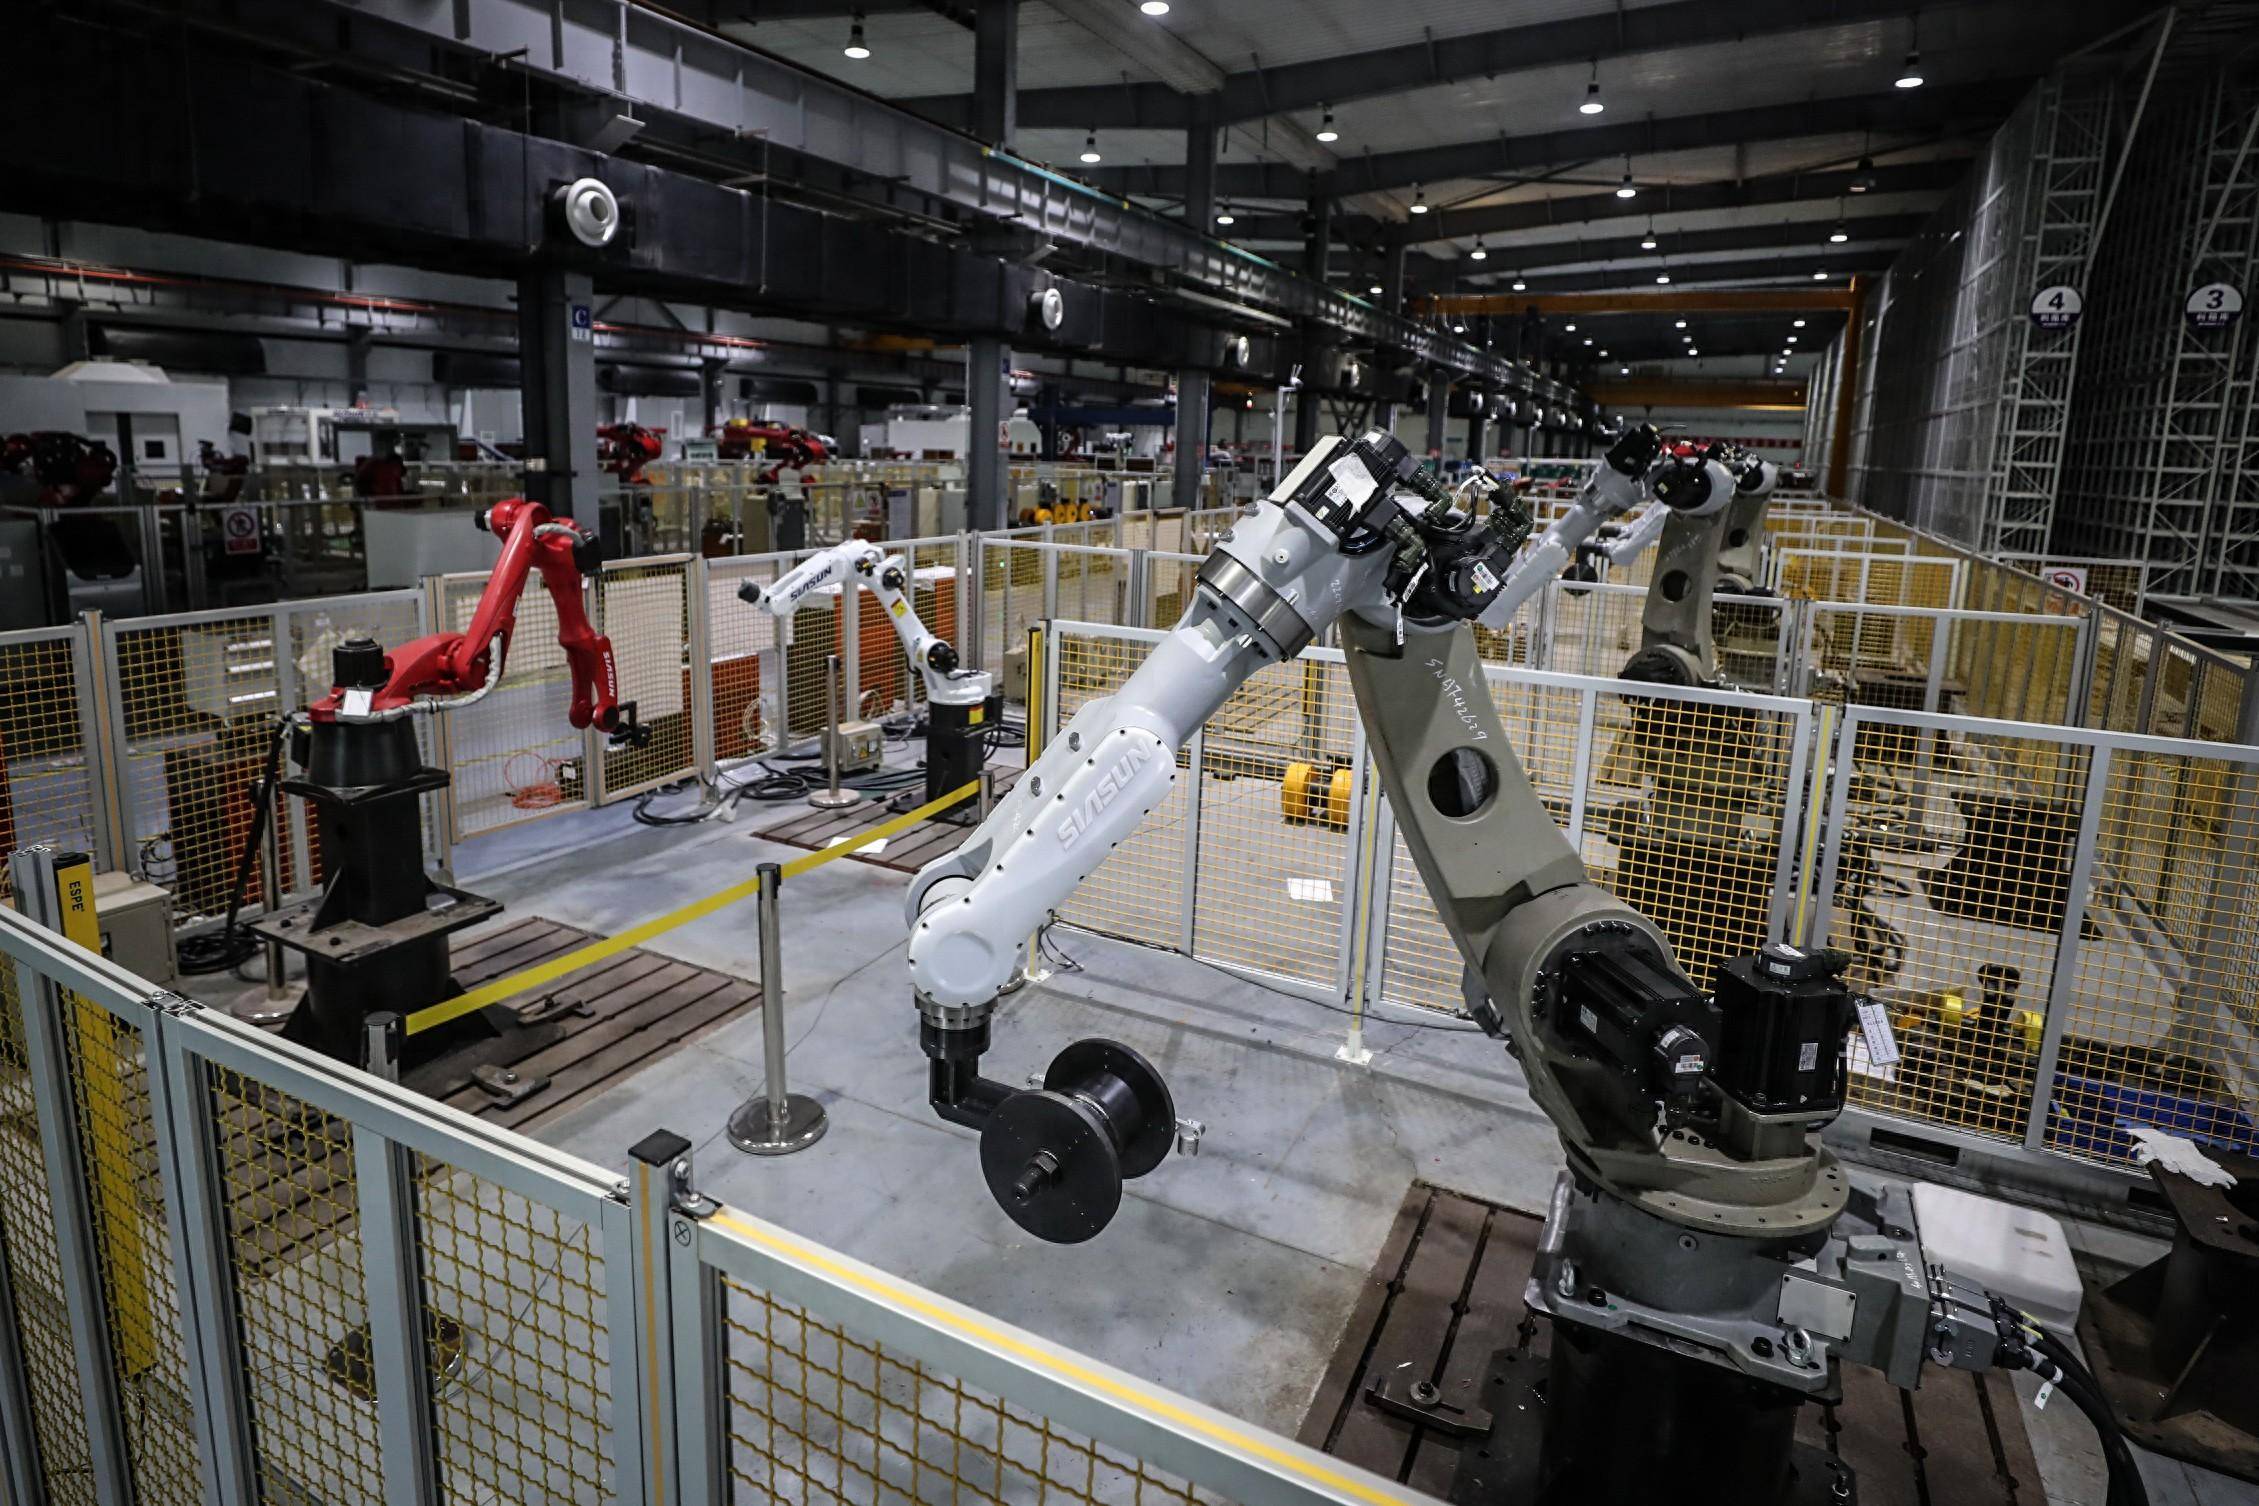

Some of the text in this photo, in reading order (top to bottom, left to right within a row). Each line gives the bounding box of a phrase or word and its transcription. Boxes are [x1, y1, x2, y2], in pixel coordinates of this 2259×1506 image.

[2048, 291, 2064, 310] 4
[2206, 289, 2224, 309] 3
[574, 308, 588, 326] C
[790, 564, 832, 602] SIASUN
[602, 650, 616, 698] SIASUN
[1056, 738, 1153, 851] SIASUN
